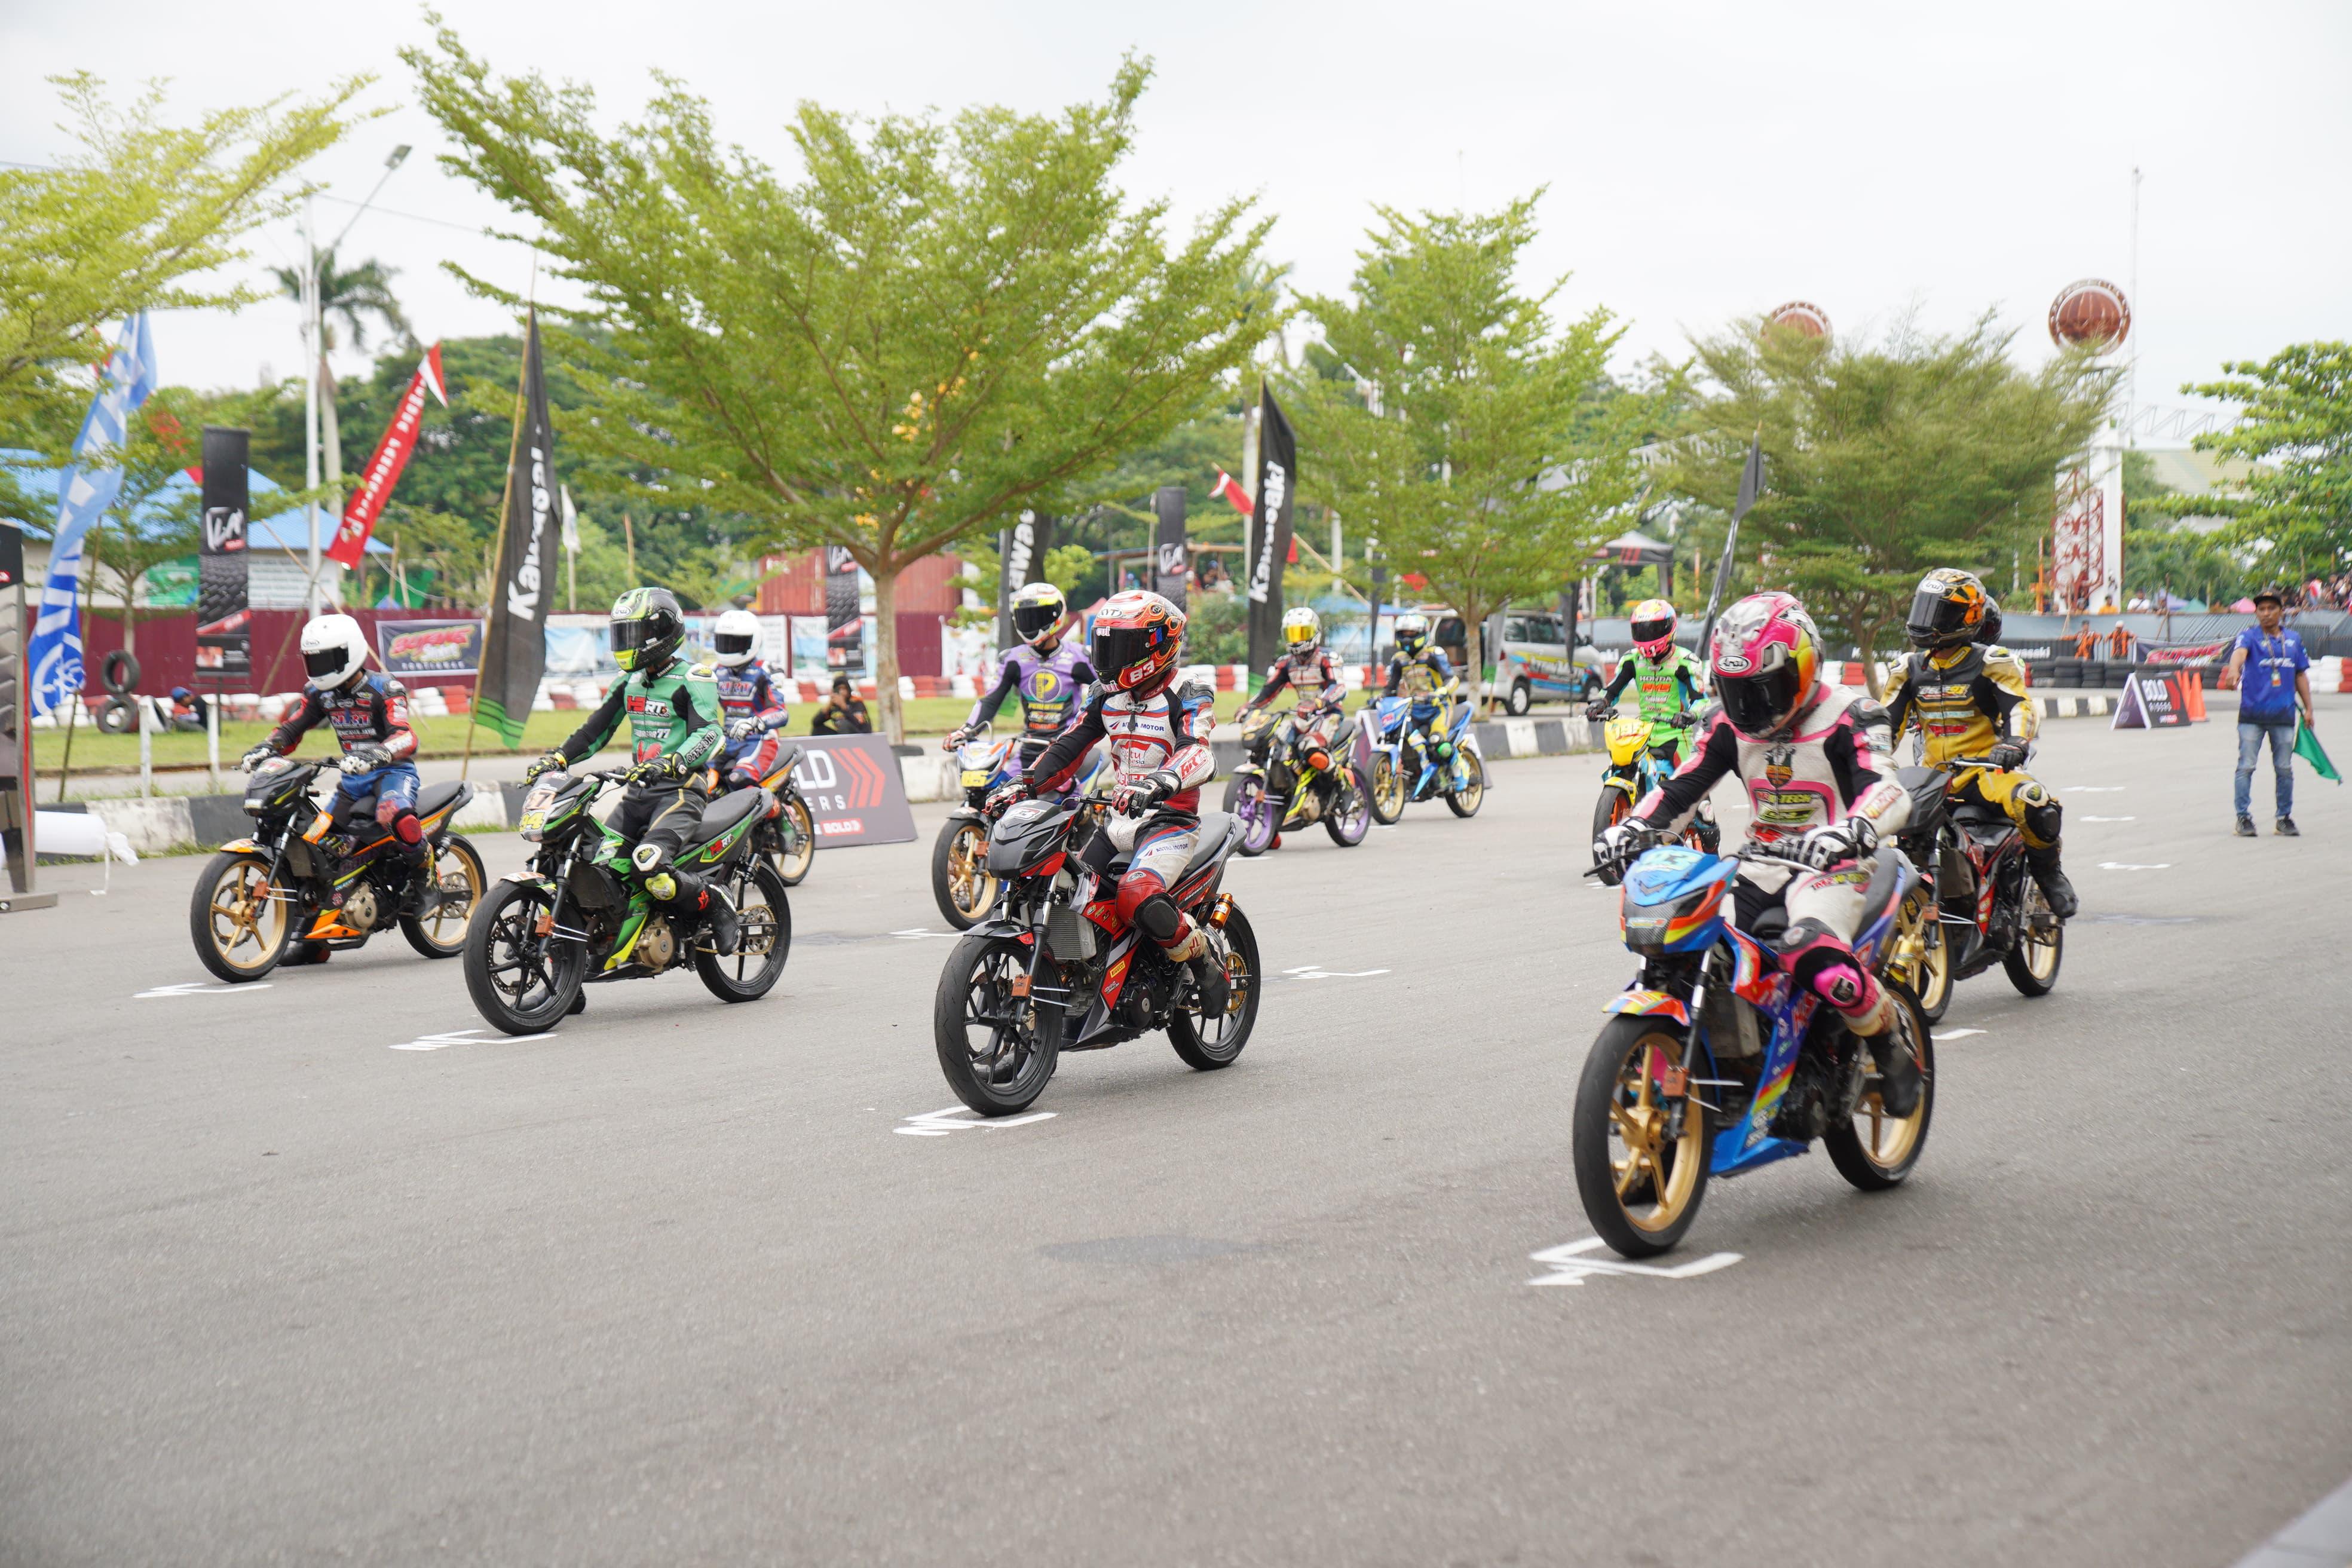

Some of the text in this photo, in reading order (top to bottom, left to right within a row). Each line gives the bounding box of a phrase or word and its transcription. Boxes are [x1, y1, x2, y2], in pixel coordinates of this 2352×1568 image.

[2009, 646, 2051, 659] wasaki
[1721, 657, 1744, 667] Arai
[1130, 660, 1155, 683] 83
[1140, 723, 1165, 731] MOTOR
[792, 749, 837, 790] LD
[804, 794, 847, 813] ERS
[1156, 843, 1189, 853] ASTRA MOTOR
[1111, 962, 1125, 976] PIRELLI
